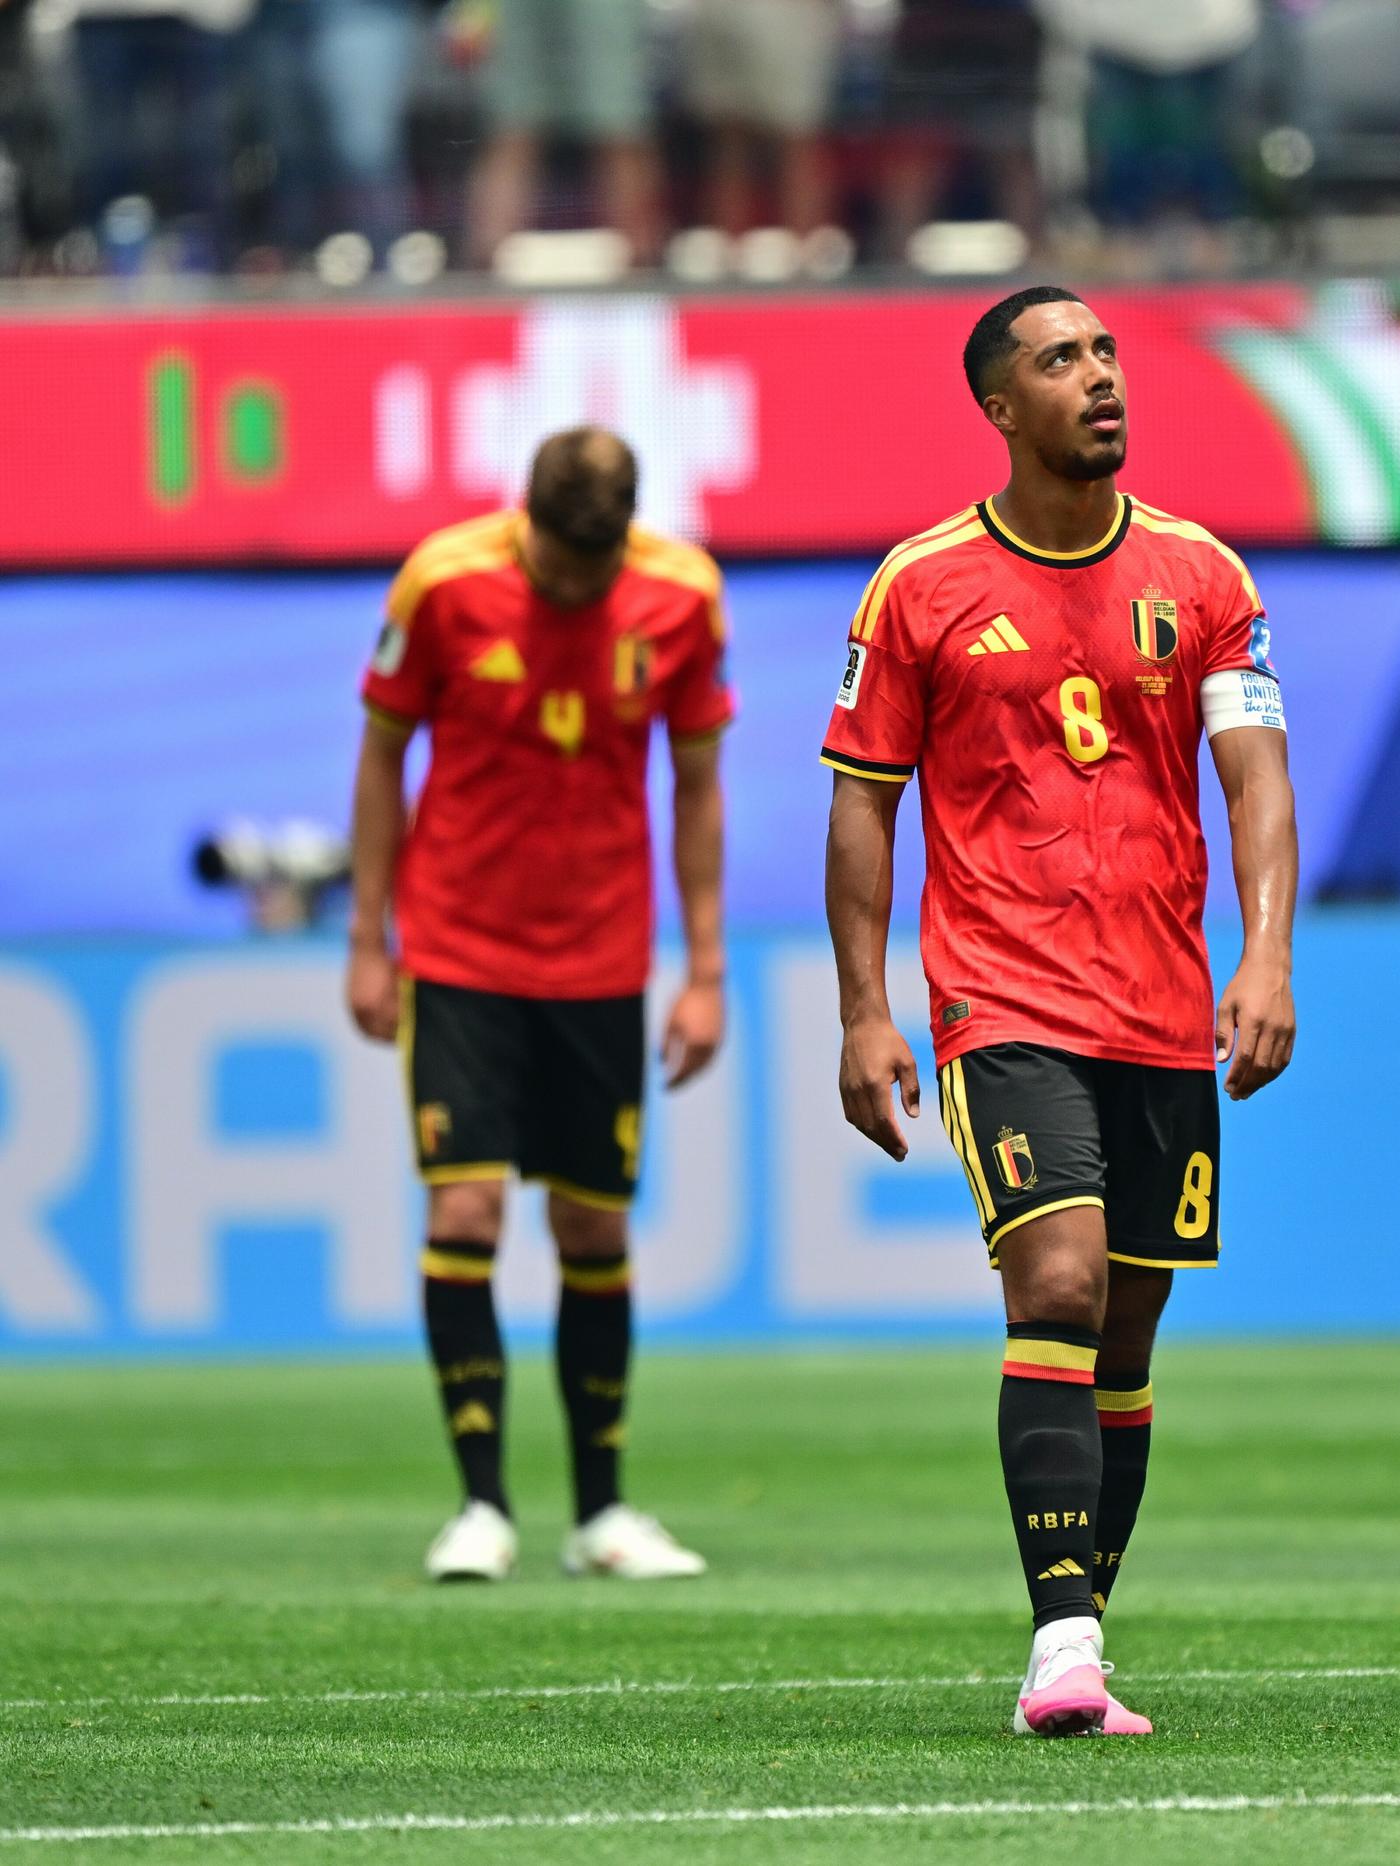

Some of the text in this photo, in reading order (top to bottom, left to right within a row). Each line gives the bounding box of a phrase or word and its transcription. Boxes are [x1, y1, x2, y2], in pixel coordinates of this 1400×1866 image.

[1059, 676, 1109, 763] 8
[1242, 699, 1263, 713] the
[1173, 1151, 1213, 1239] 8
[1027, 1510, 1089, 1530] RBFA
